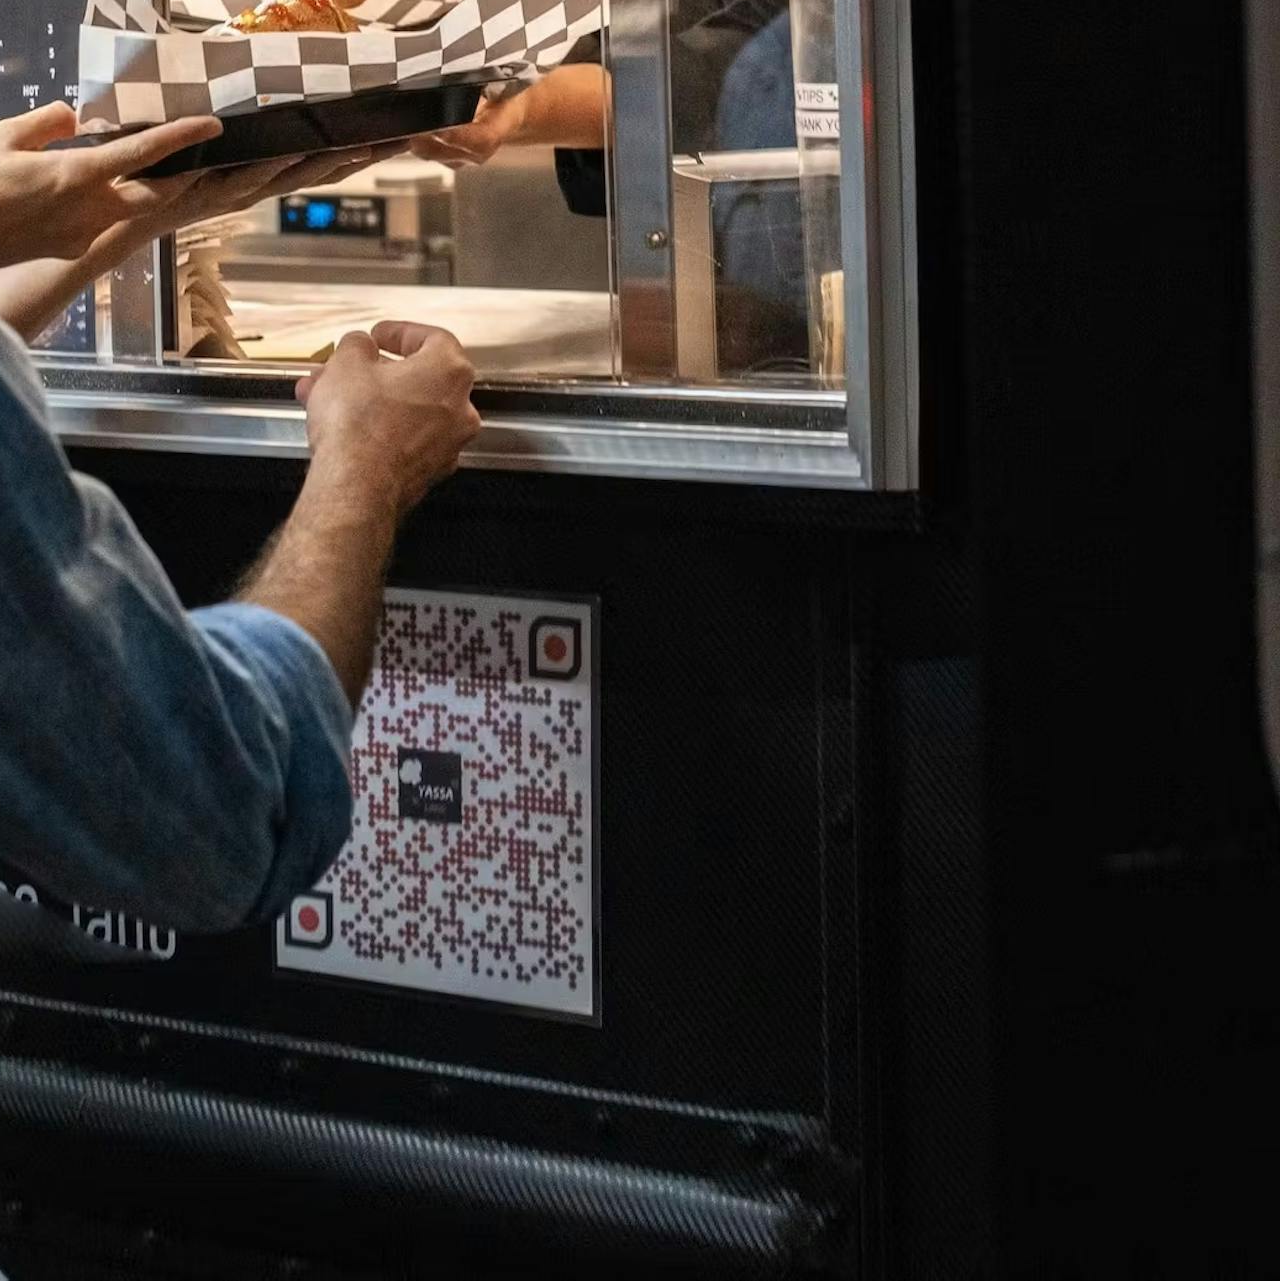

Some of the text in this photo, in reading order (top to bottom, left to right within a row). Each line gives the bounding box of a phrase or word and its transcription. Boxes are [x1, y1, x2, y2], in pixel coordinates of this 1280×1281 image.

[23, 85, 39, 96] HOT
[65, 85, 78, 96] ICE
[802, 89, 824, 103] TIPS
[798, 117, 840, 132] HANK YO
[418, 784, 454, 802] YASSA
